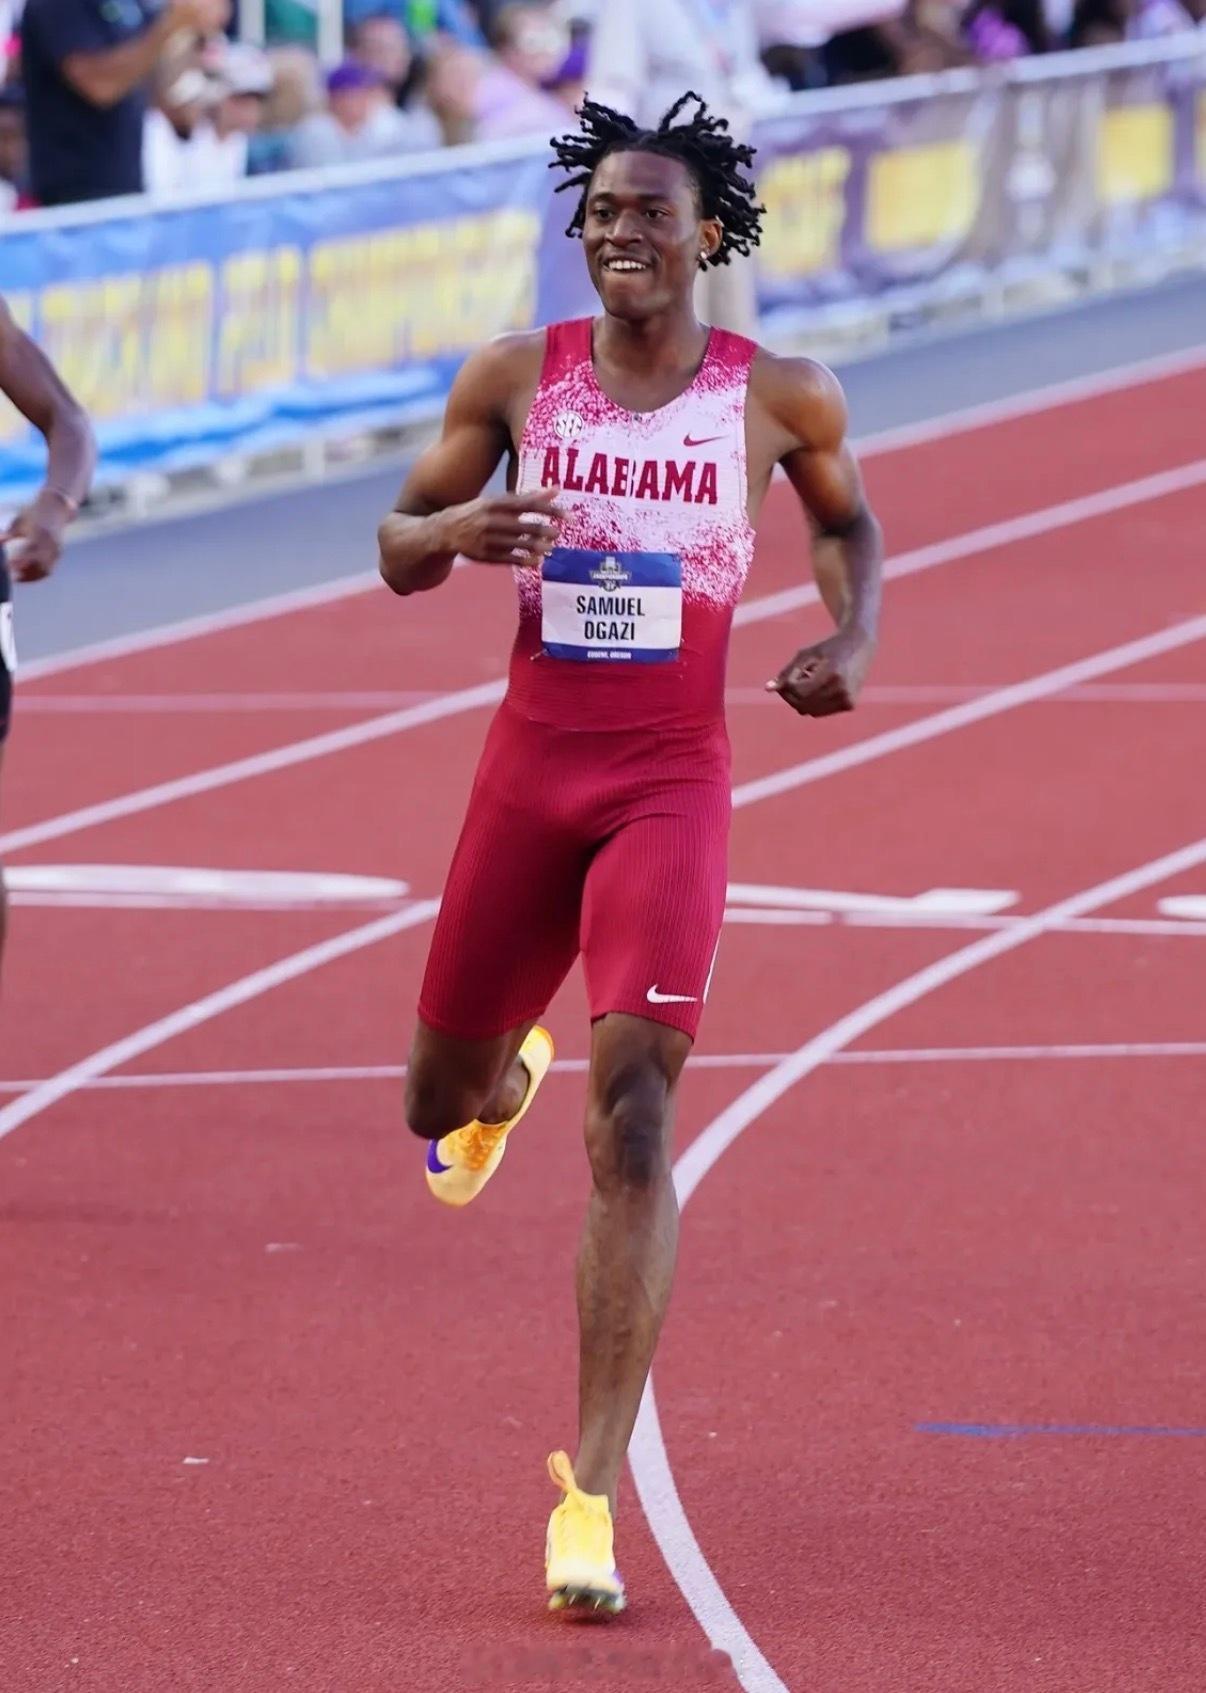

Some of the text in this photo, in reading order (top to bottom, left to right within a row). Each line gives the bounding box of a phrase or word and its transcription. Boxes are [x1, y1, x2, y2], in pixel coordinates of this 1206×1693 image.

[541, 446, 718, 505] ALABAMA
[576, 595, 646, 617] SAMUEL
[584, 621, 636, 641] OGAZI
